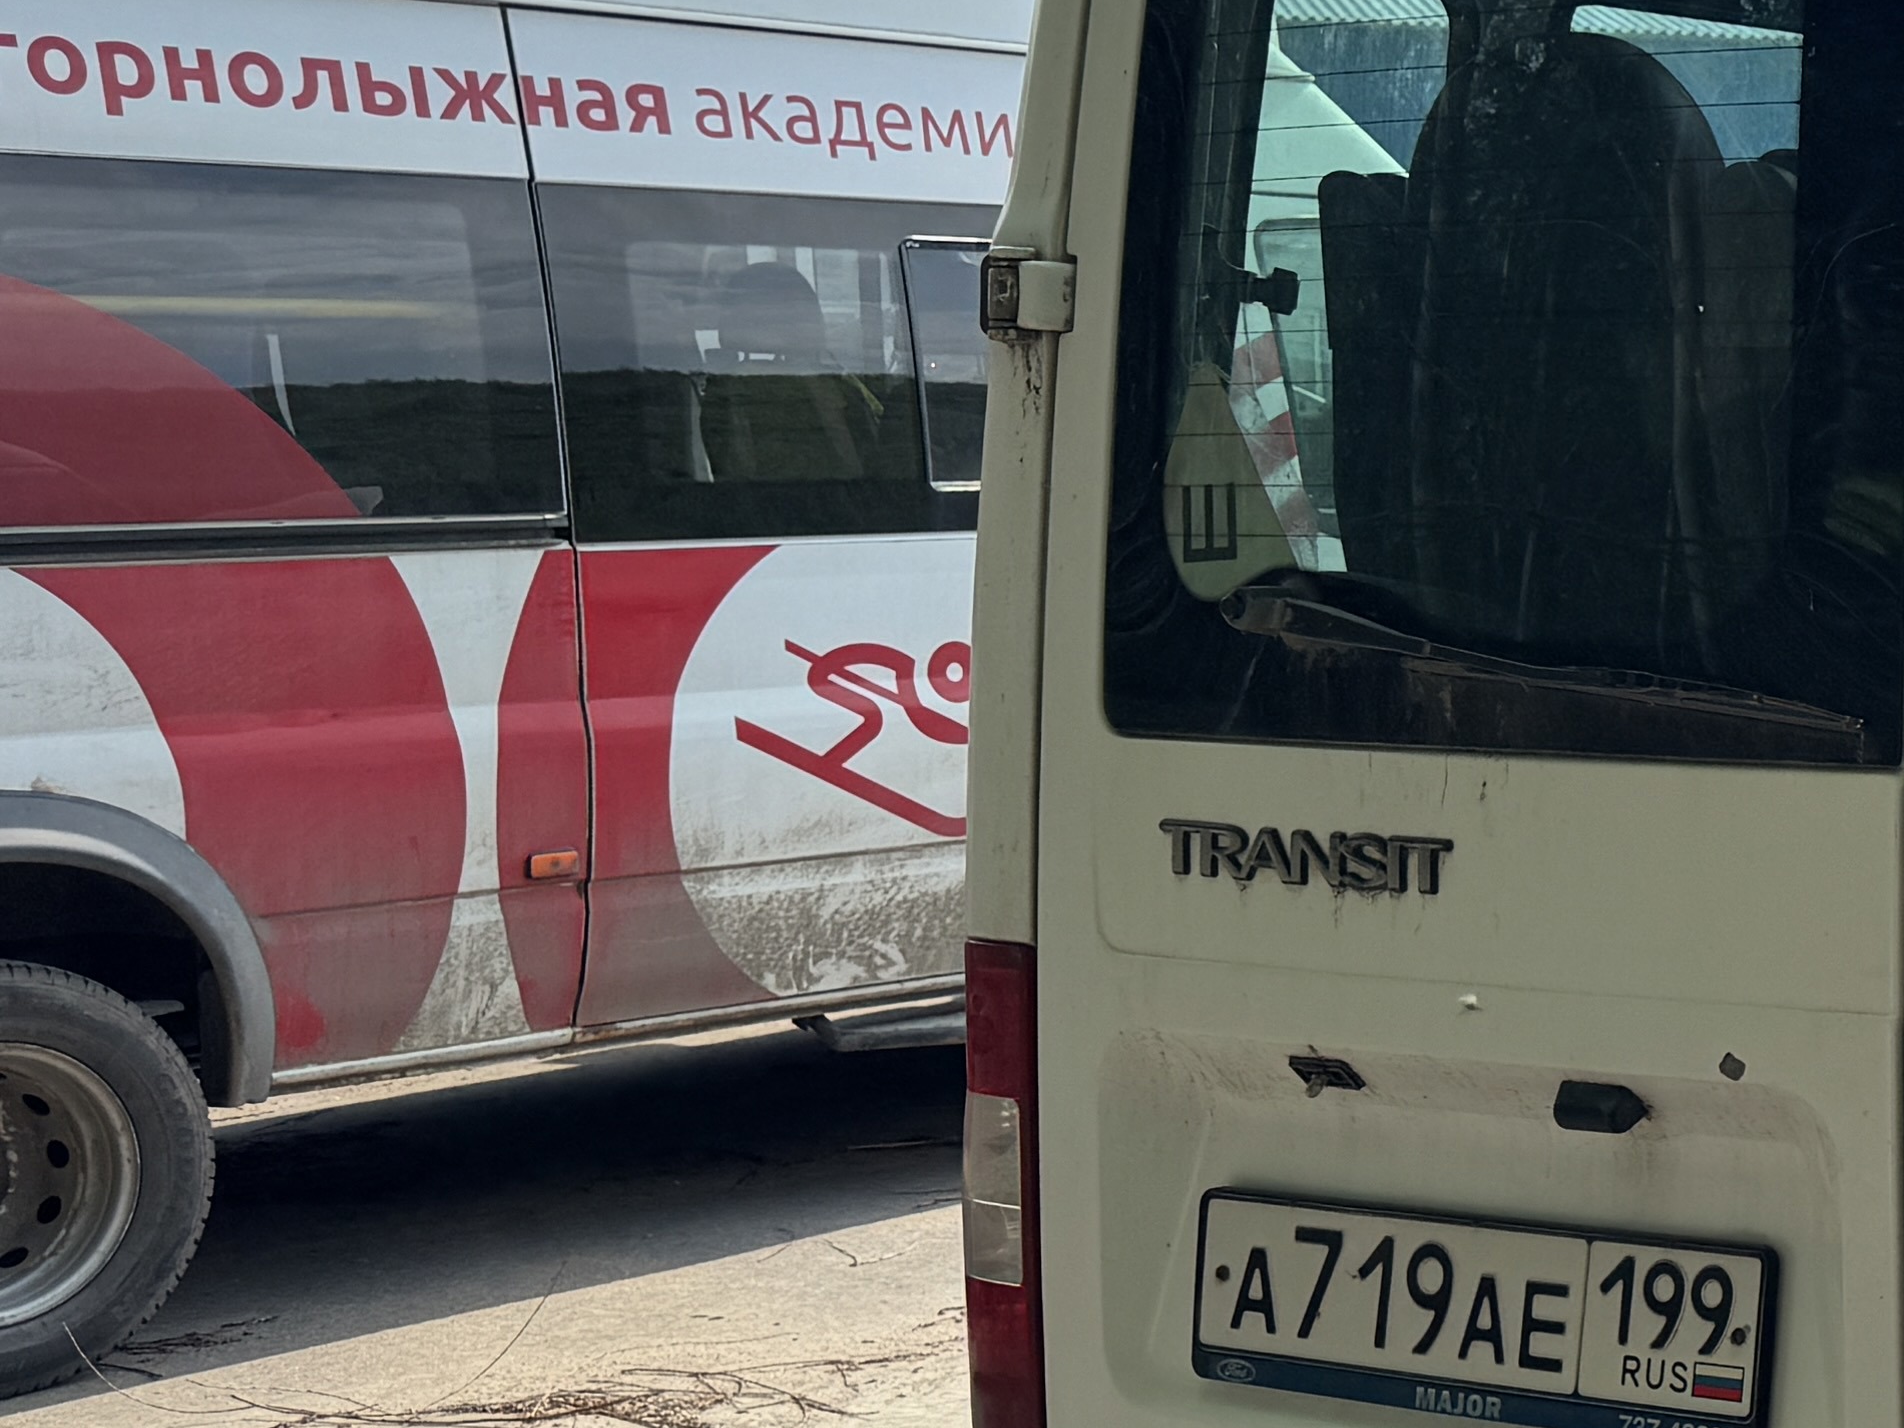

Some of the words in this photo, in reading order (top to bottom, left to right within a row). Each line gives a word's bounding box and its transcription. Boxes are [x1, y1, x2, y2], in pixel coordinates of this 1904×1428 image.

[694, 87, 1013, 161] академи
[1158, 818, 1454, 895] TRANSIT
[1230, 1225, 1571, 1373] А719АЕ
[1600, 1255, 1735, 1356] 199
[1414, 1385, 1502, 1420] MAJOR
[1620, 1355, 1688, 1393] RUS
